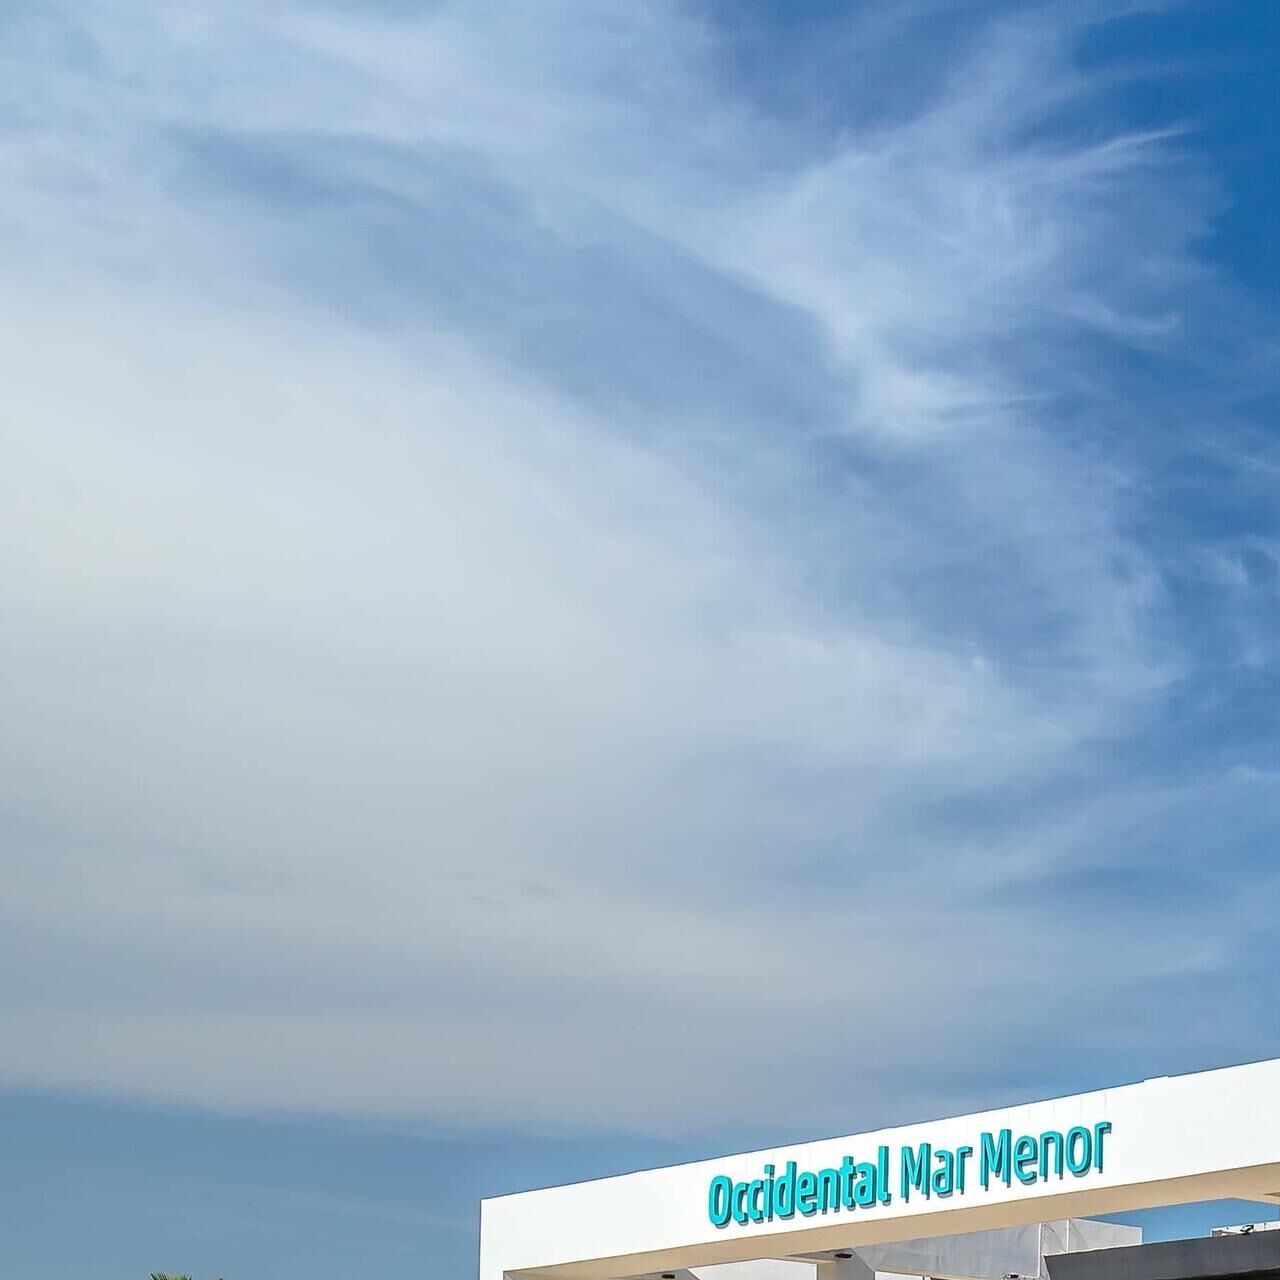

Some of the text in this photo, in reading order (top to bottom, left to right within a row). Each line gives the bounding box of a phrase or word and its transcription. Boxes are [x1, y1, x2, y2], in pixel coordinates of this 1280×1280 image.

[708, 1121, 1112, 1229] Occidental Mar Menor
